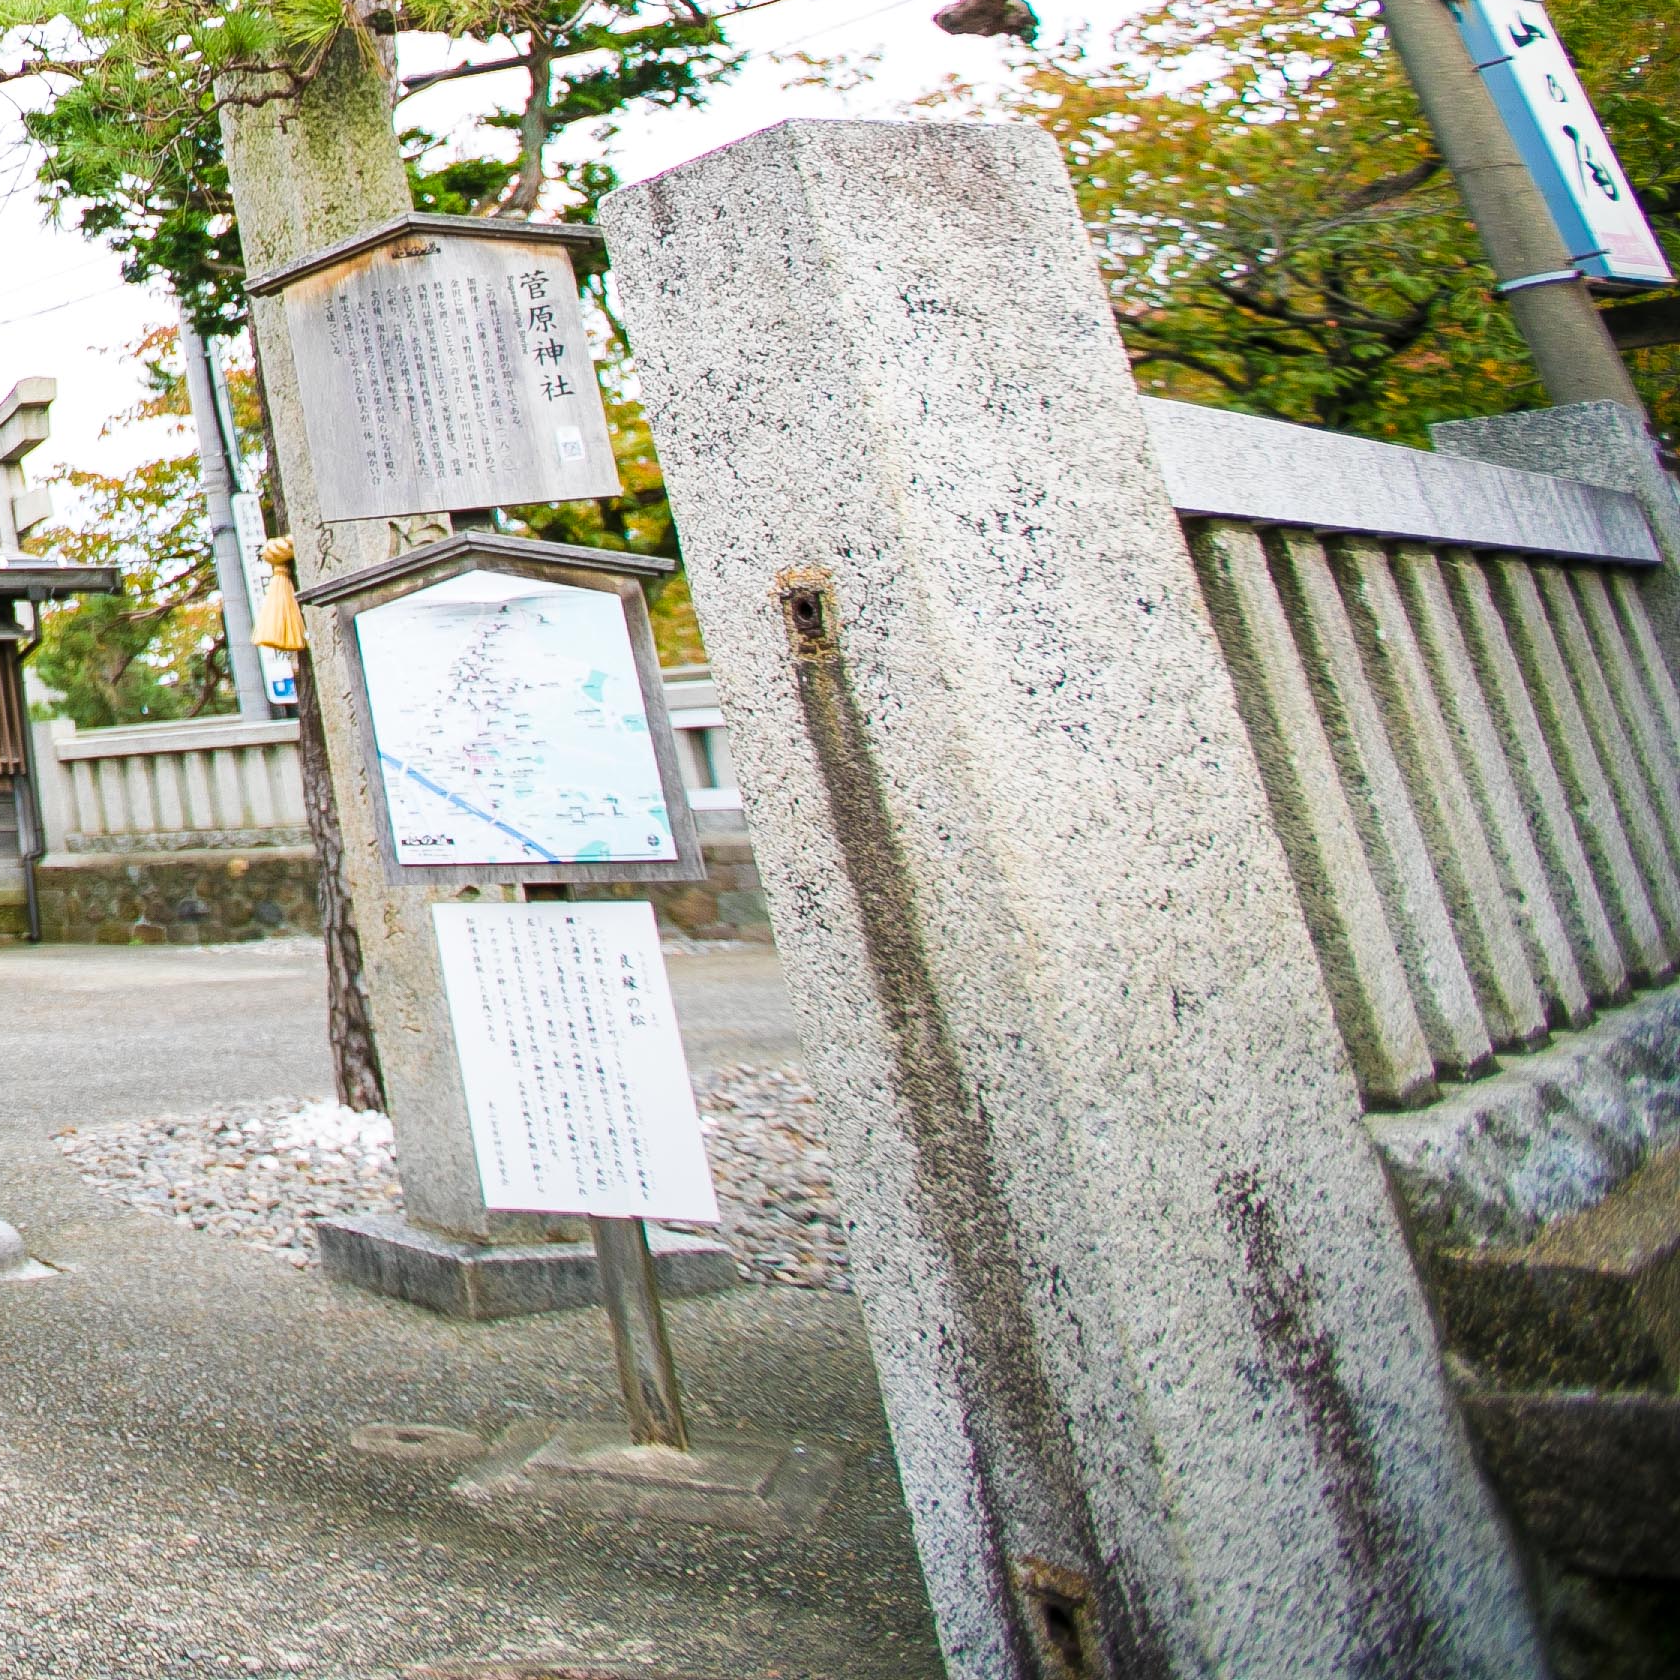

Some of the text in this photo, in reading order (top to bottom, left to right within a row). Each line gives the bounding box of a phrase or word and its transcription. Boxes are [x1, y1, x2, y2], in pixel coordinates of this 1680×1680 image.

[520, 269, 575, 402] 菅原神社
[616, 952, 646, 1026] 良縁の松
